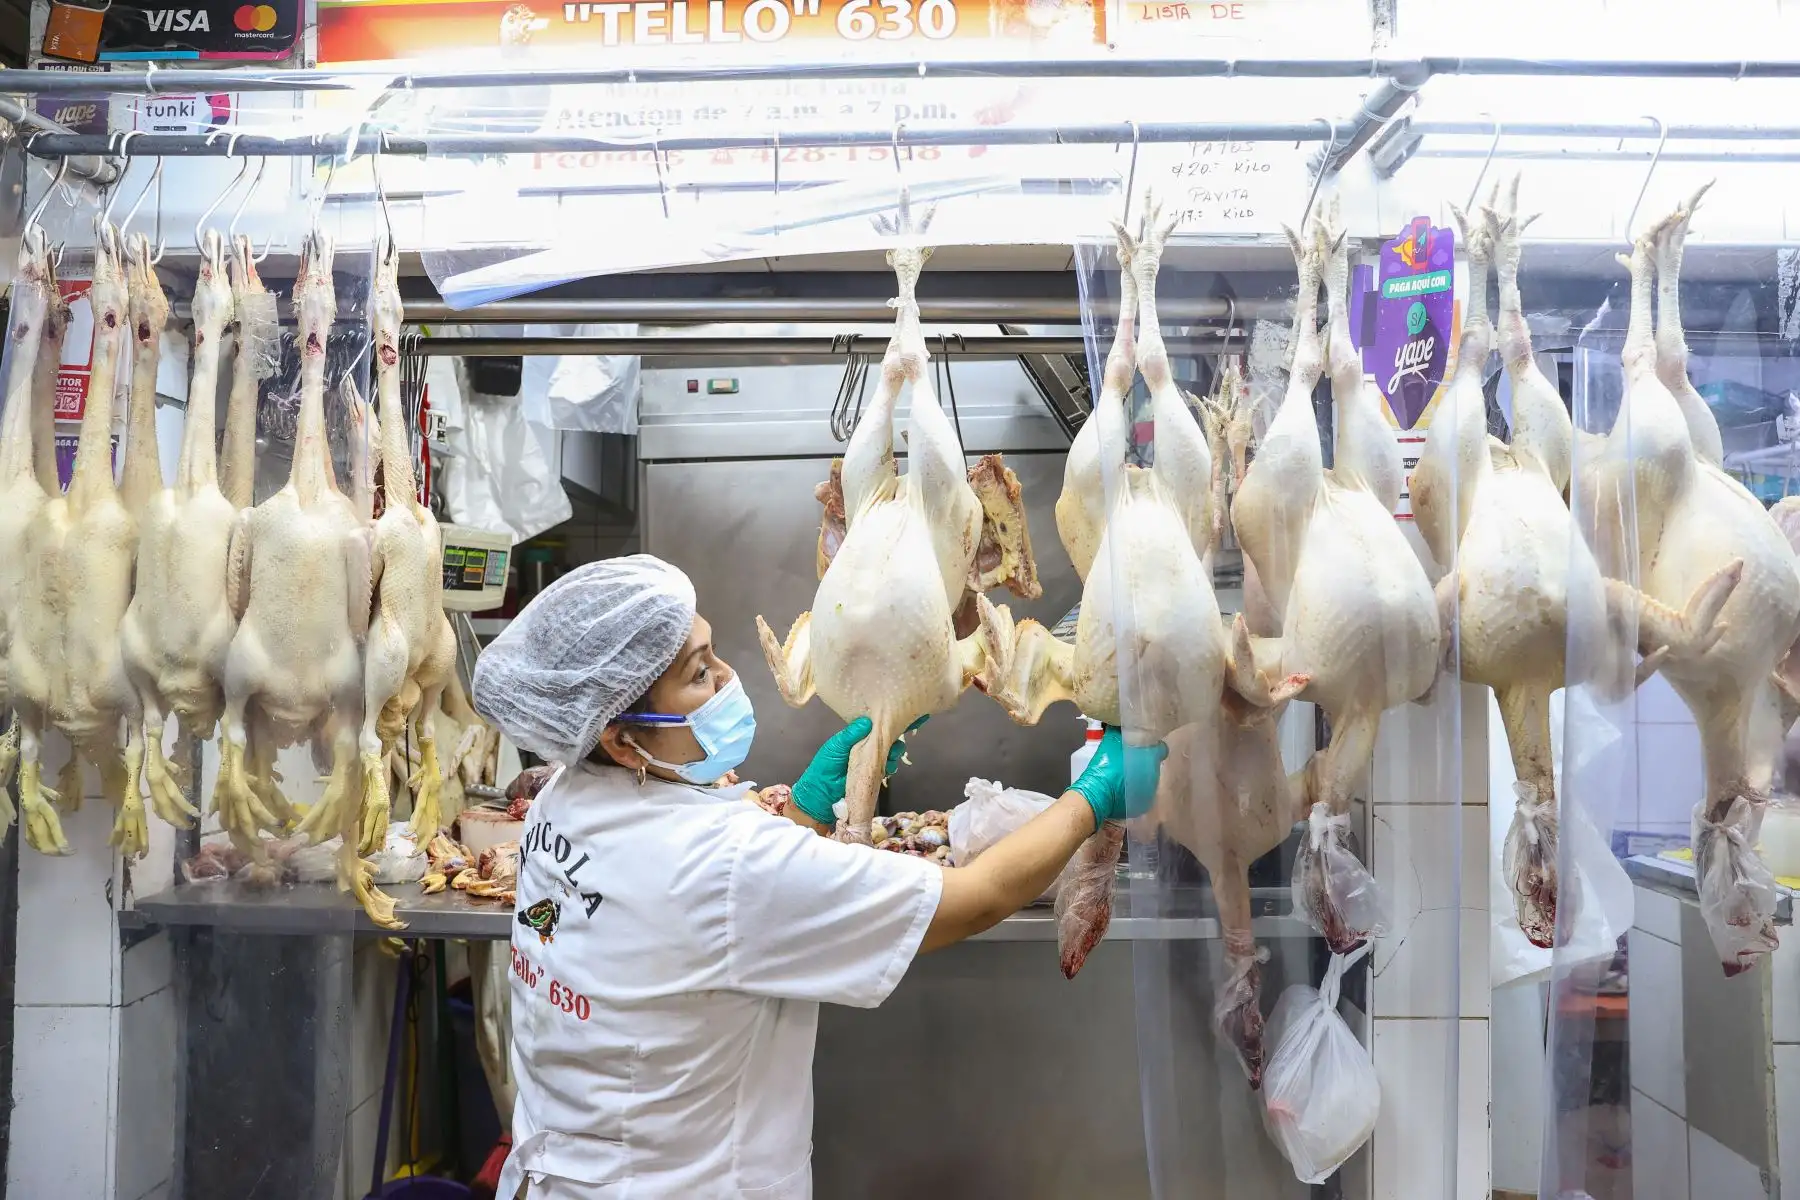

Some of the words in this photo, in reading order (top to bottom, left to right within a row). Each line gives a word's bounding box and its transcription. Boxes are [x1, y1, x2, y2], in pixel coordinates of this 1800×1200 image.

[142, 9, 210, 32] VISA
[1142, 3, 1191, 20] LISTA
[1210, 3, 1246, 20] DE
[563, 0, 823, 46] "TELLO"
[835, 0, 960, 41] 630
[234, 31, 275, 39] mastercard
[54, 104, 97, 127] yape
[145, 100, 195, 117] tunki
[893, 102, 958, 123] p.m.
[1188, 186, 1249, 202] PAVITA
[1389, 283, 1411, 294] PAGA
[1431, 275, 1447, 288] CON
[1387, 336, 1435, 394] yape
[55, 377, 82, 387] NTOR
[549, 979, 591, 1021] 630
